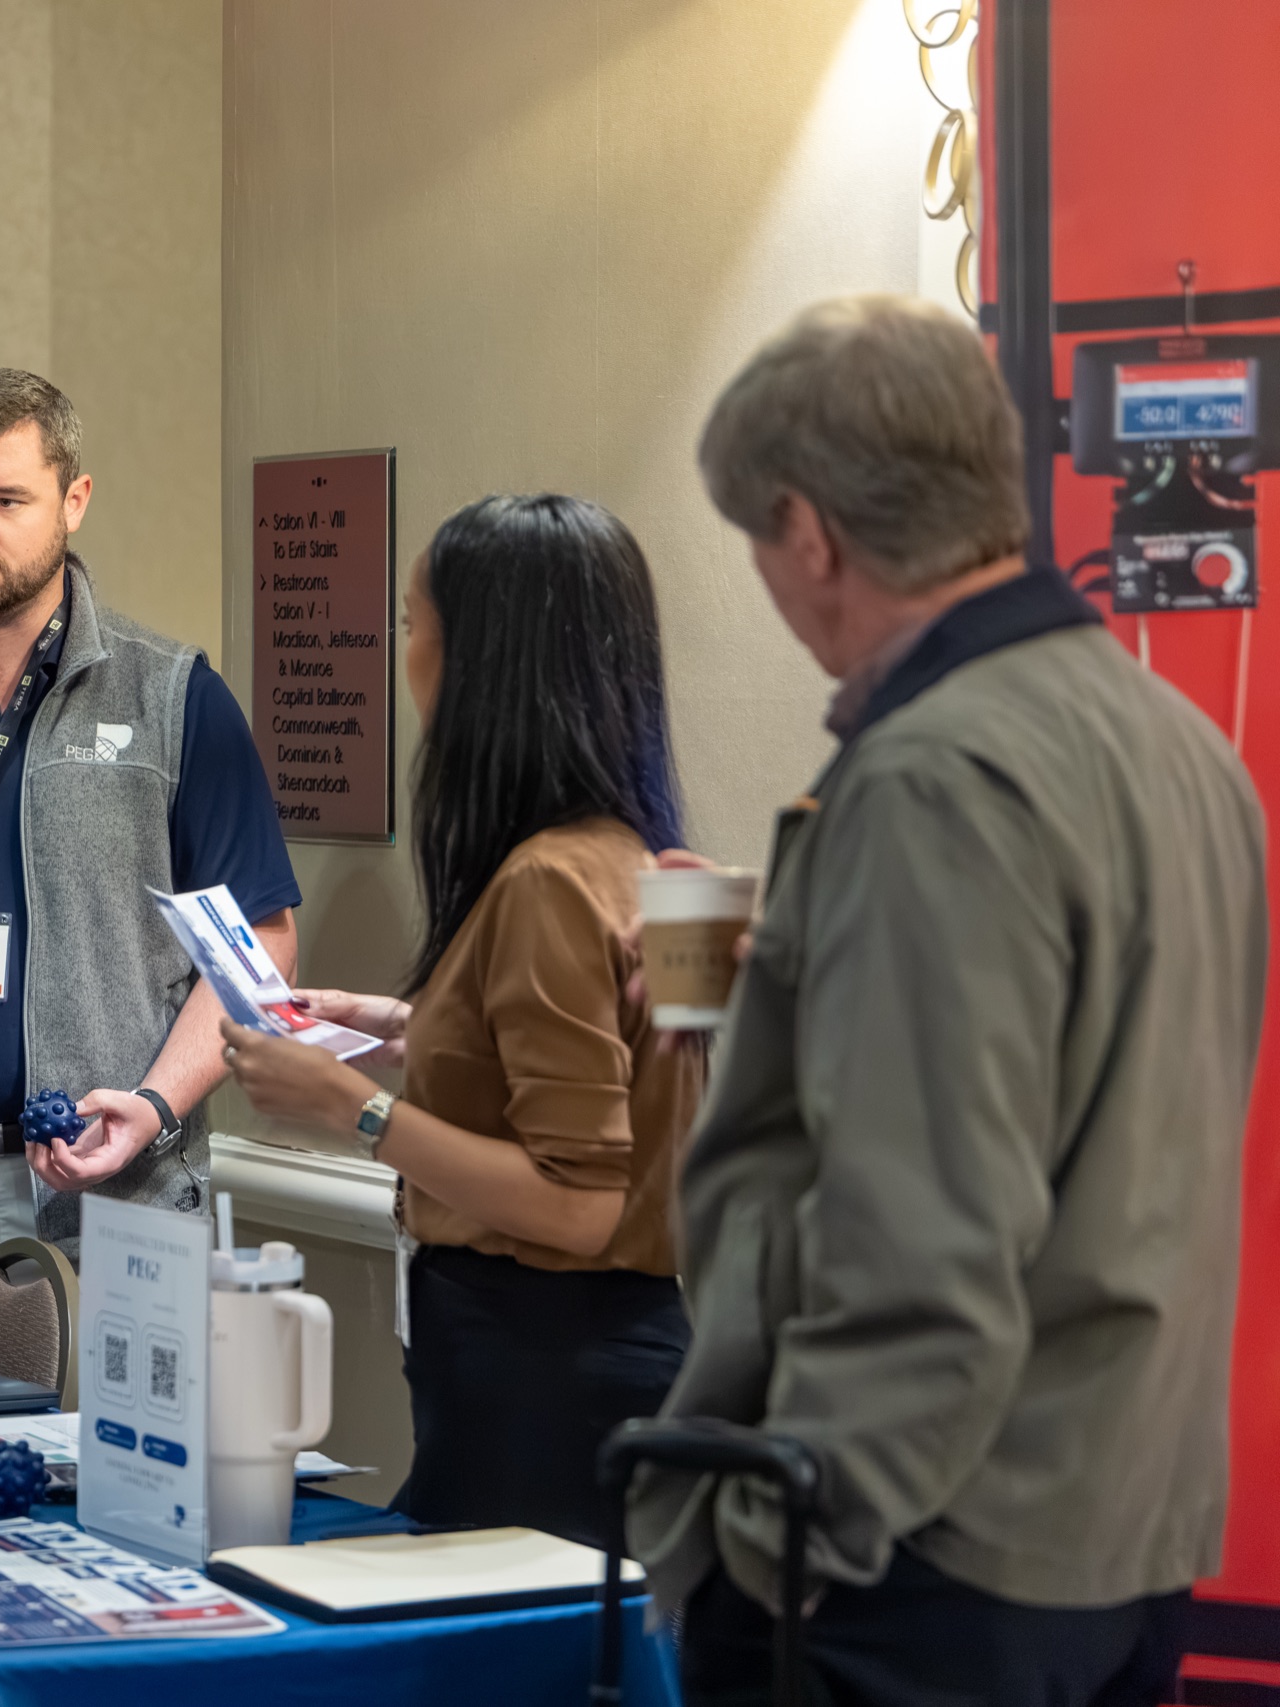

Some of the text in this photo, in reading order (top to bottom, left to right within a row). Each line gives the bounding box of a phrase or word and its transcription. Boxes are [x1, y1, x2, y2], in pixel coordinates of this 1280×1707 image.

[273, 512, 304, 531] Salon
[307, 511, 318, 529] VI
[329, 510, 346, 529] VIII
[273, 539, 339, 560] To Exit Stairs
[273, 573, 330, 592] Restrooms
[273, 602, 304, 621] Salon
[307, 601, 316, 620] V
[273, 630, 379, 651] Madison, Jefferson
[278, 659, 334, 677] & Monroe
[13, 687, 28, 712] TERRA
[272, 687, 367, 710] Capital Ballroom
[272, 715, 365, 738] Commonwealth,
[65, 743, 94, 761] PEG
[277, 744, 344, 764] Dominion &
[277, 772, 351, 794] Shenandoah
[274, 800, 320, 821] levators
[175, 1195, 191, 1208] NORTH
